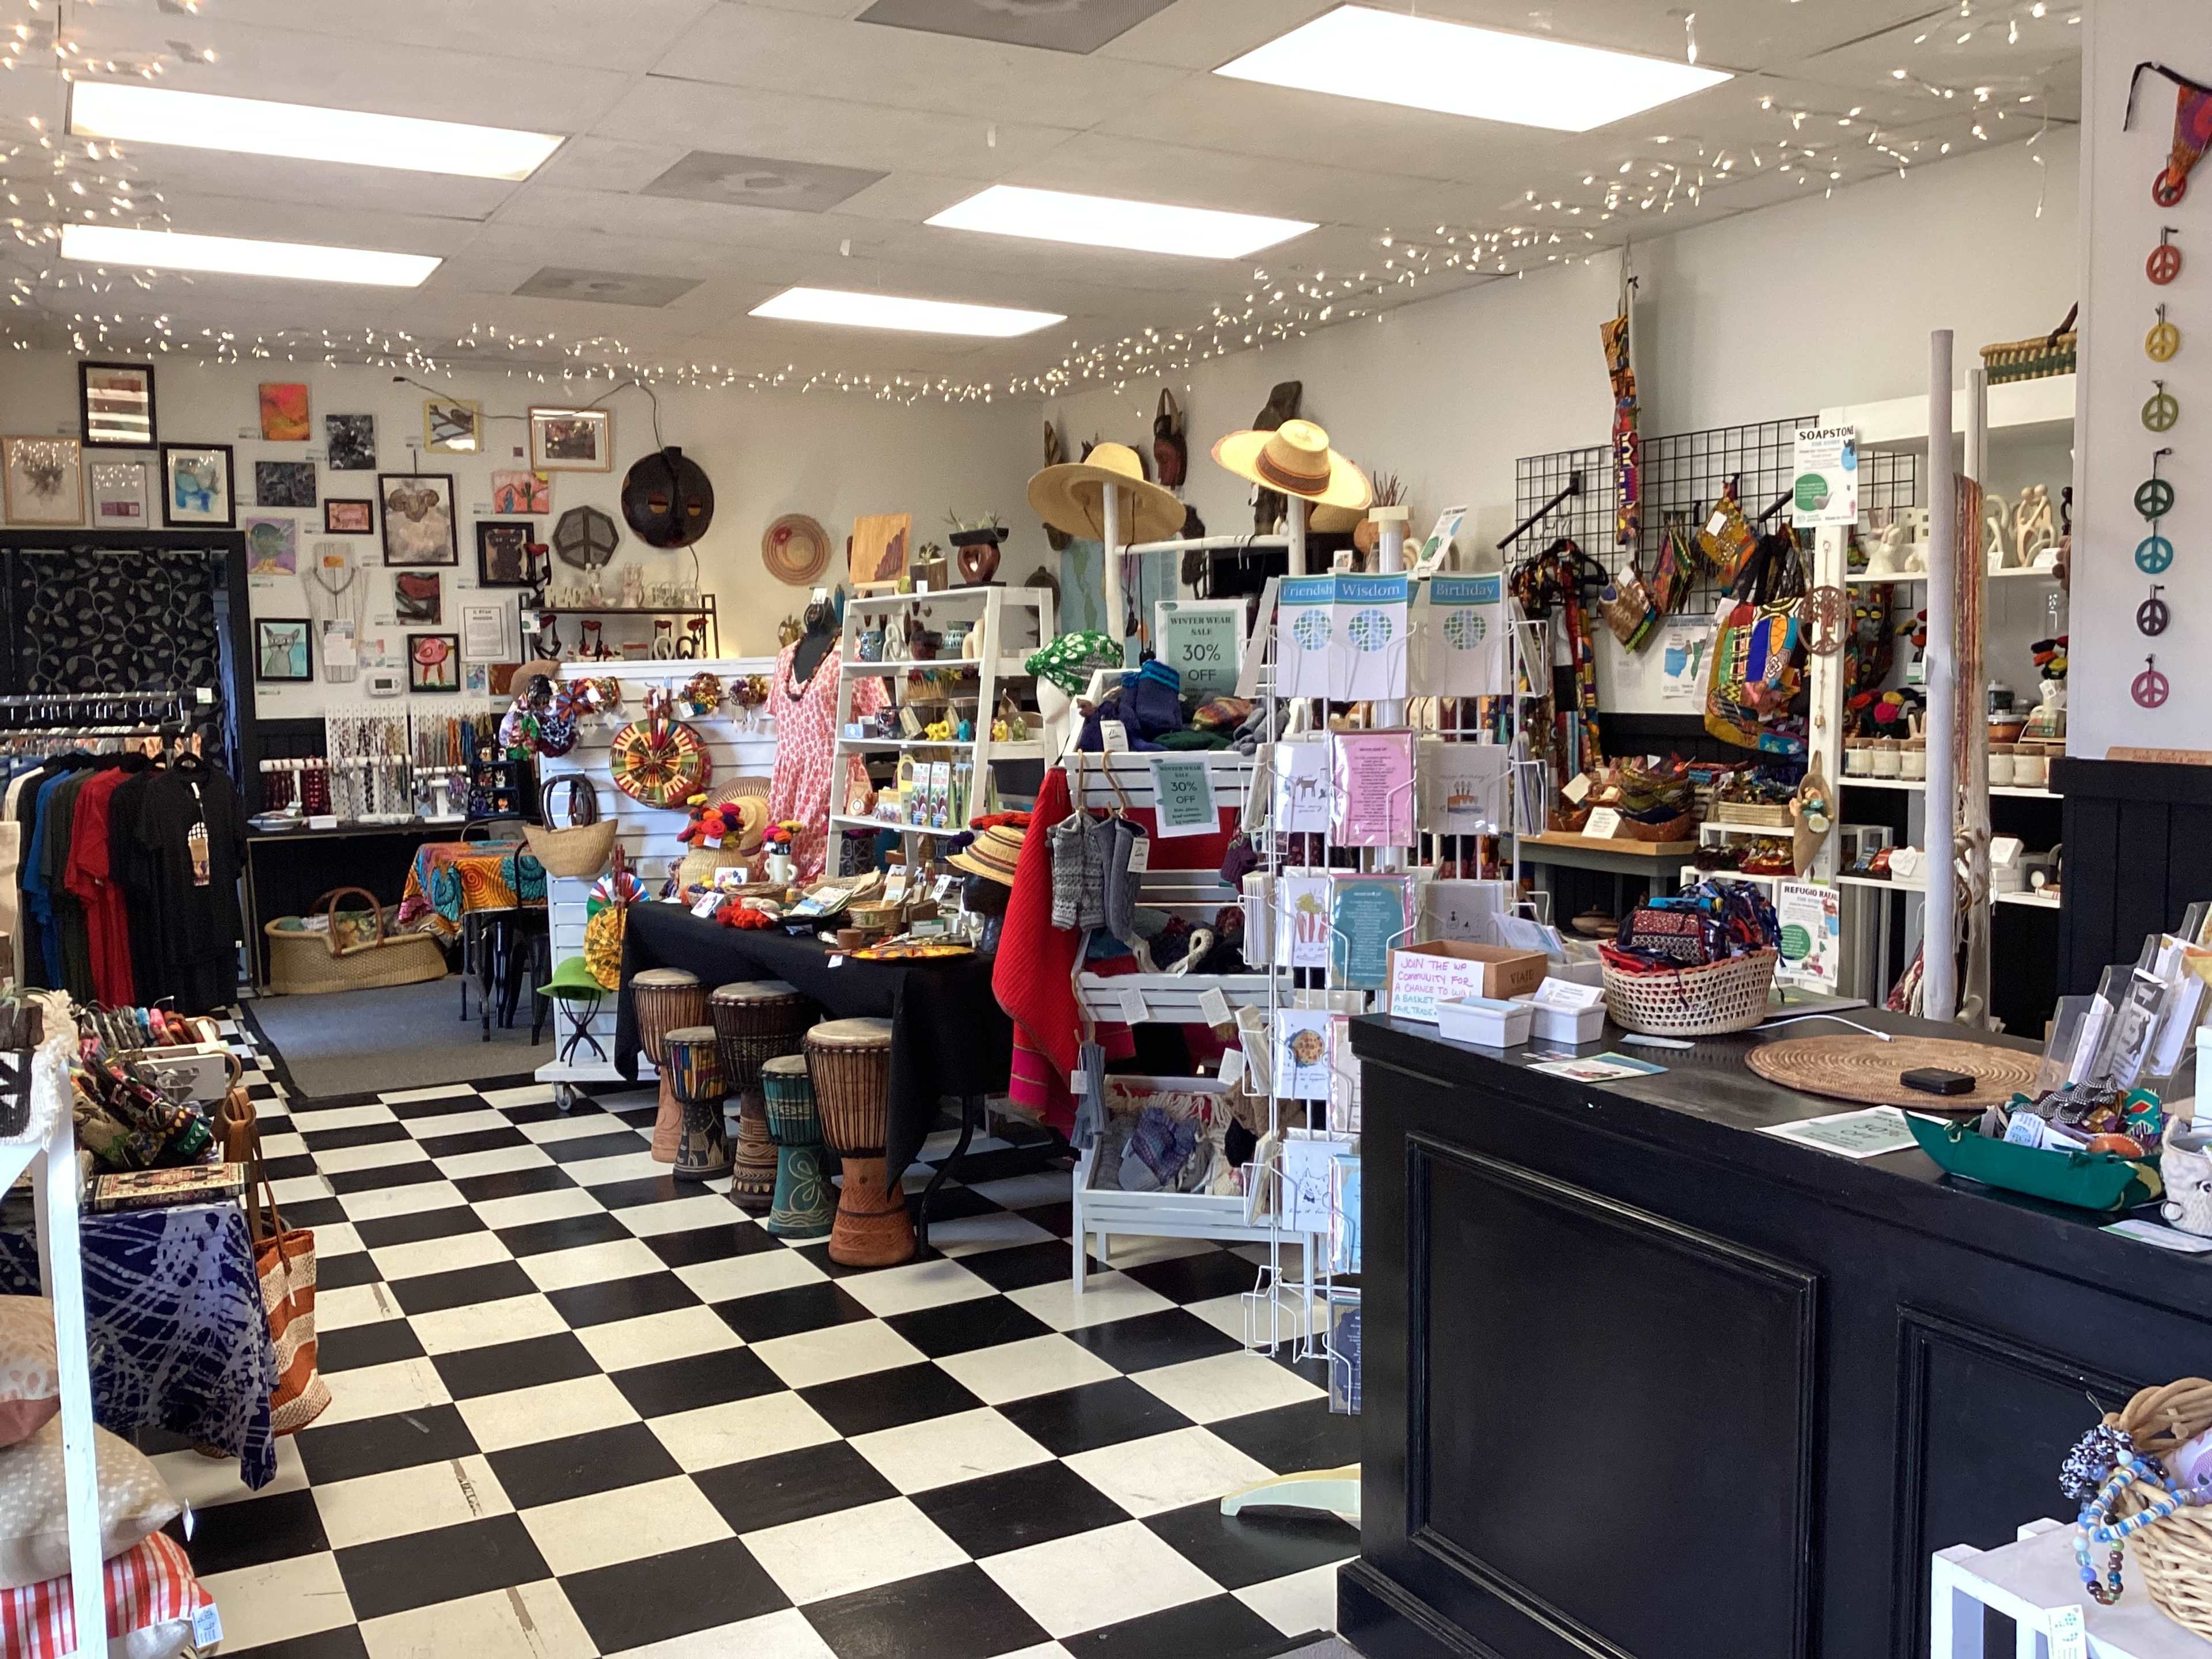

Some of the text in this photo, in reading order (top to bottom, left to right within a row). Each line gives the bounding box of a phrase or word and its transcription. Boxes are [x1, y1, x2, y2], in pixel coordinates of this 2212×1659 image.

[1342, 582, 1400, 597] Wisdom
[1437, 583, 1494, 599] Birthday
[1171, 616, 1204, 625] WINTER
[1182, 643, 1221, 661] 30%
[1188, 669, 1217, 681] OFF
[1171, 781, 1198, 792] 30%
[1176, 795, 1196, 804] OFF
[1784, 886, 1817, 897] REFUGIO
[1401, 957, 1424, 969] JOIN
[1428, 960, 1450, 971] THE
[1451, 976, 1474, 988] FOR
[1394, 982, 1401, 992] A
[1404, 983, 1434, 994] CHANCE
[1437, 986, 1448, 995] TO
[1394, 994, 1434, 1004] A BASKET
[1392, 1005, 1410, 1014] FAIR
